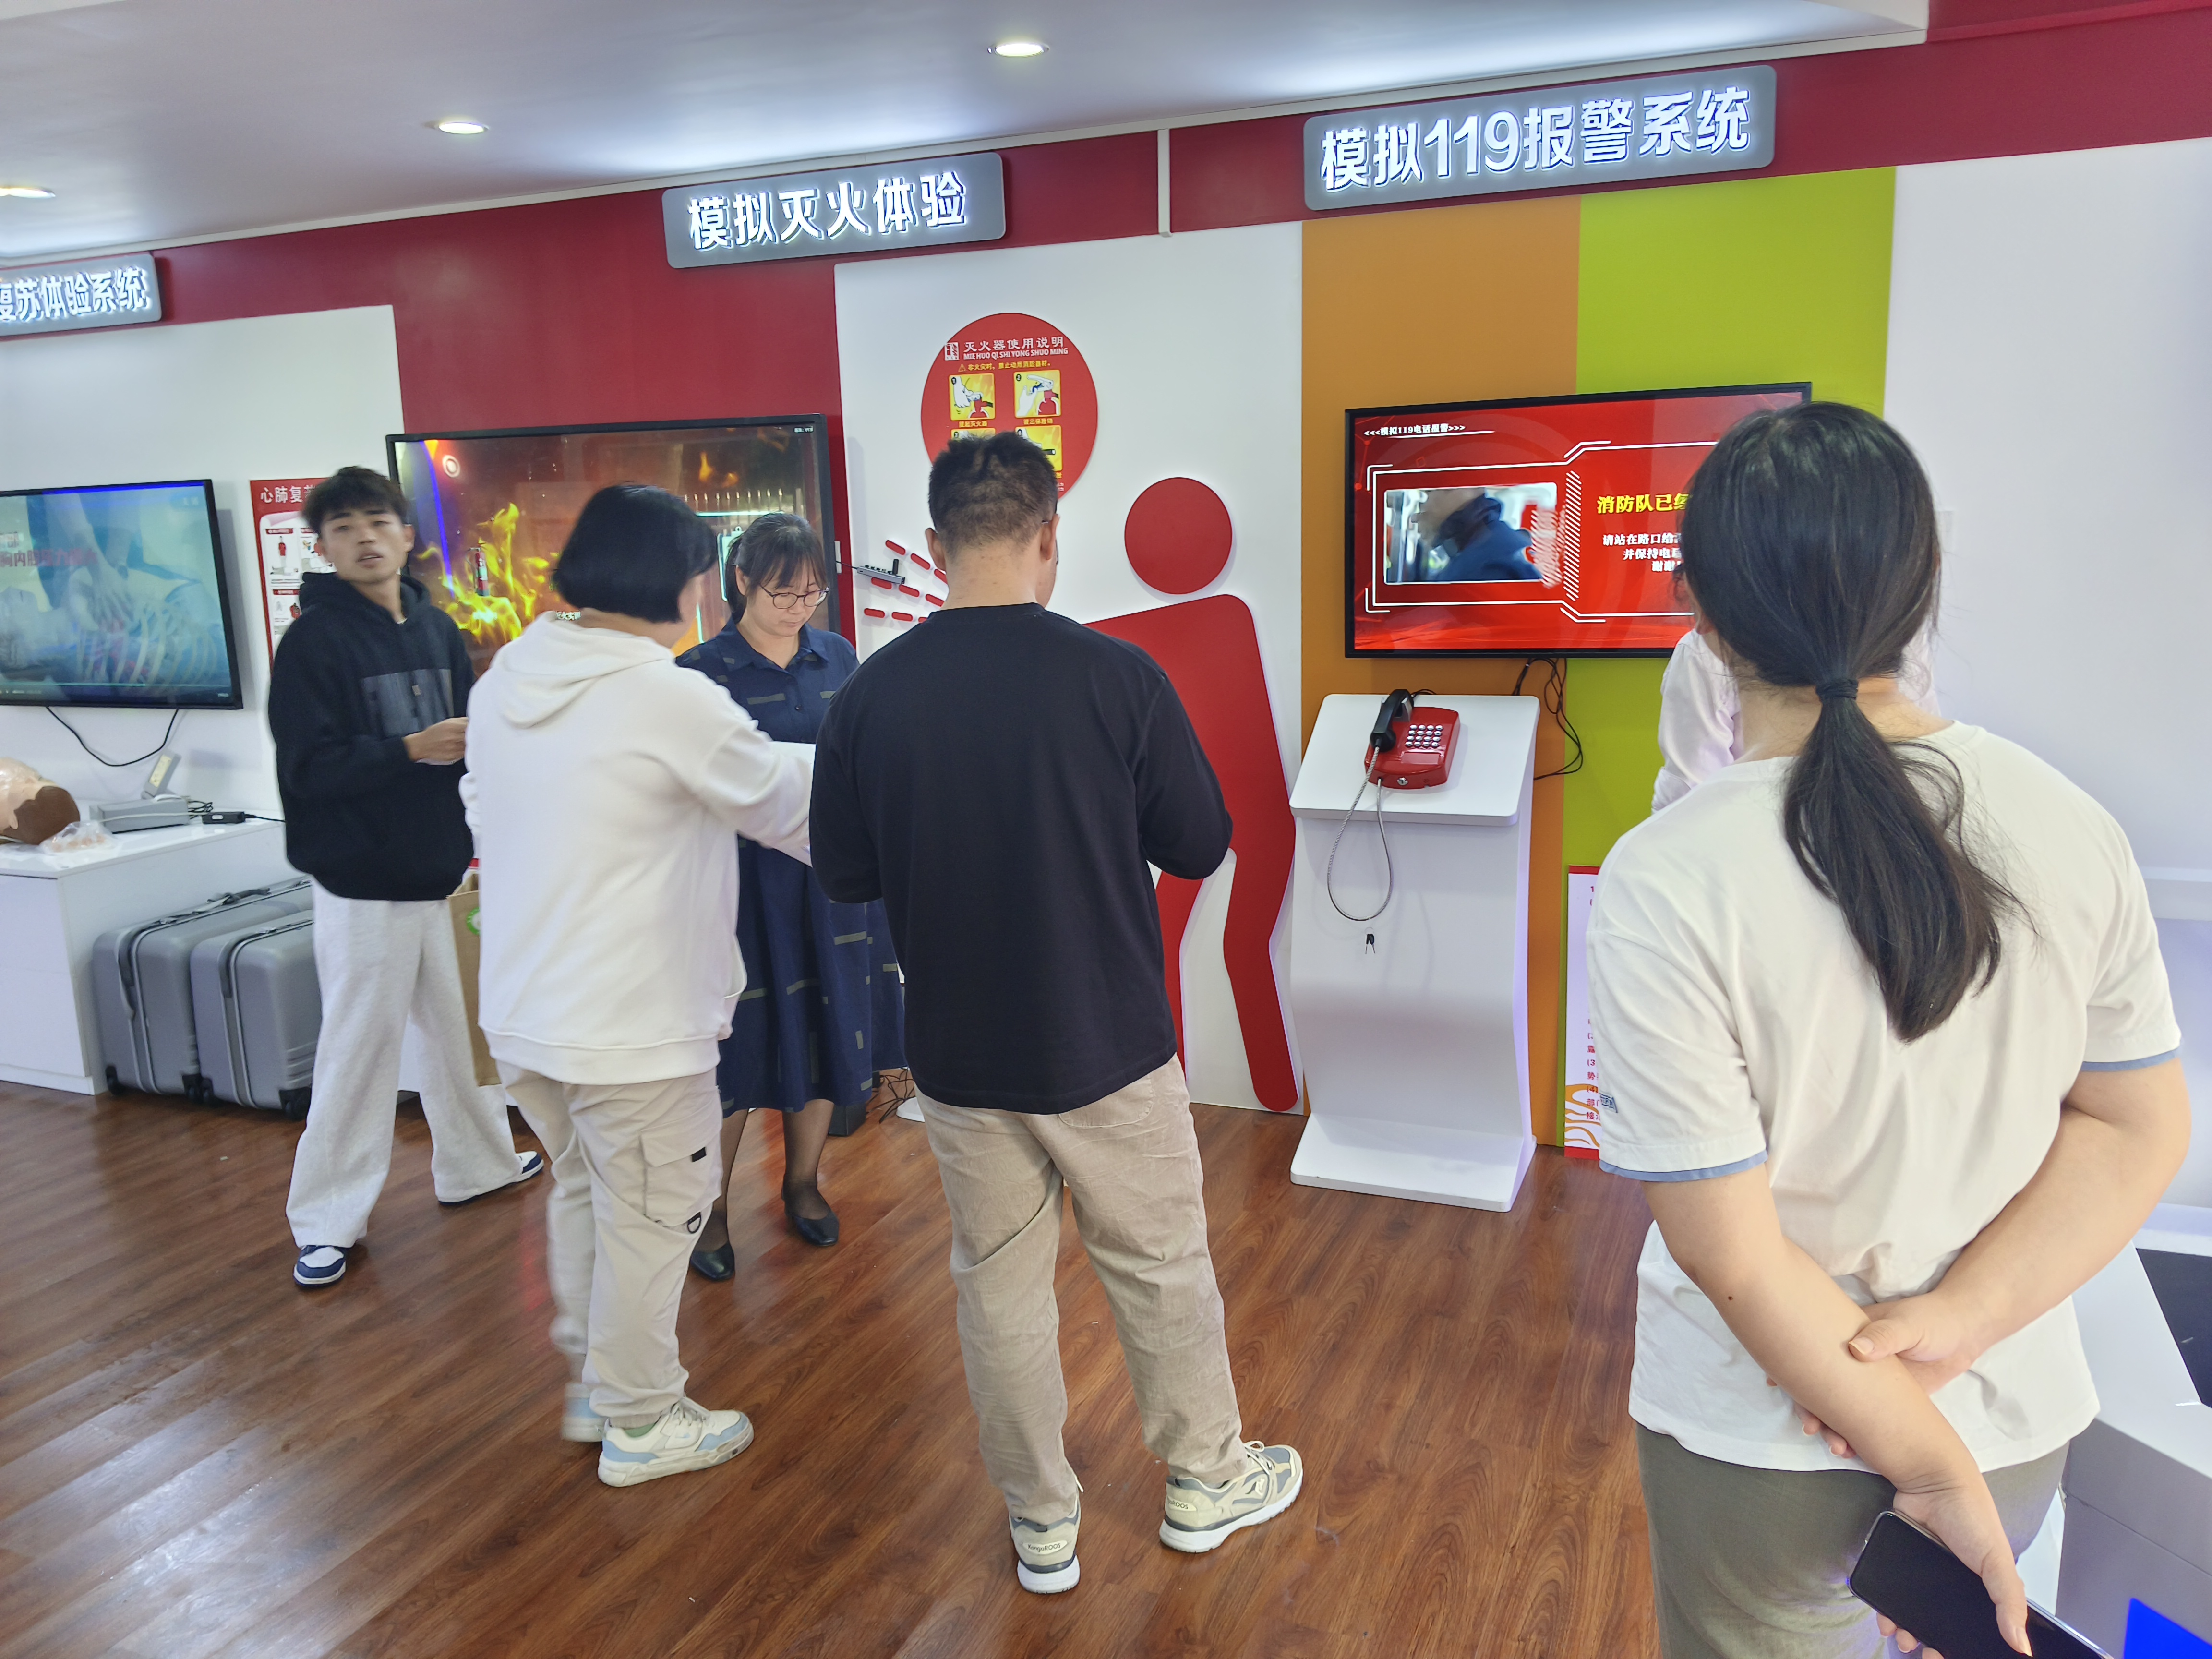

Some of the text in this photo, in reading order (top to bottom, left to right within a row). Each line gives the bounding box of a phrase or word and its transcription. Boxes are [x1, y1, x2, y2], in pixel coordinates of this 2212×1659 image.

[1321, 87, 1750, 192] 模拟119报警系统
[688, 170, 967, 251] 模拟灭火体验
[963, 336, 1064, 352] 灭火器使用说明
[1050, 347, 1069, 355] MING
